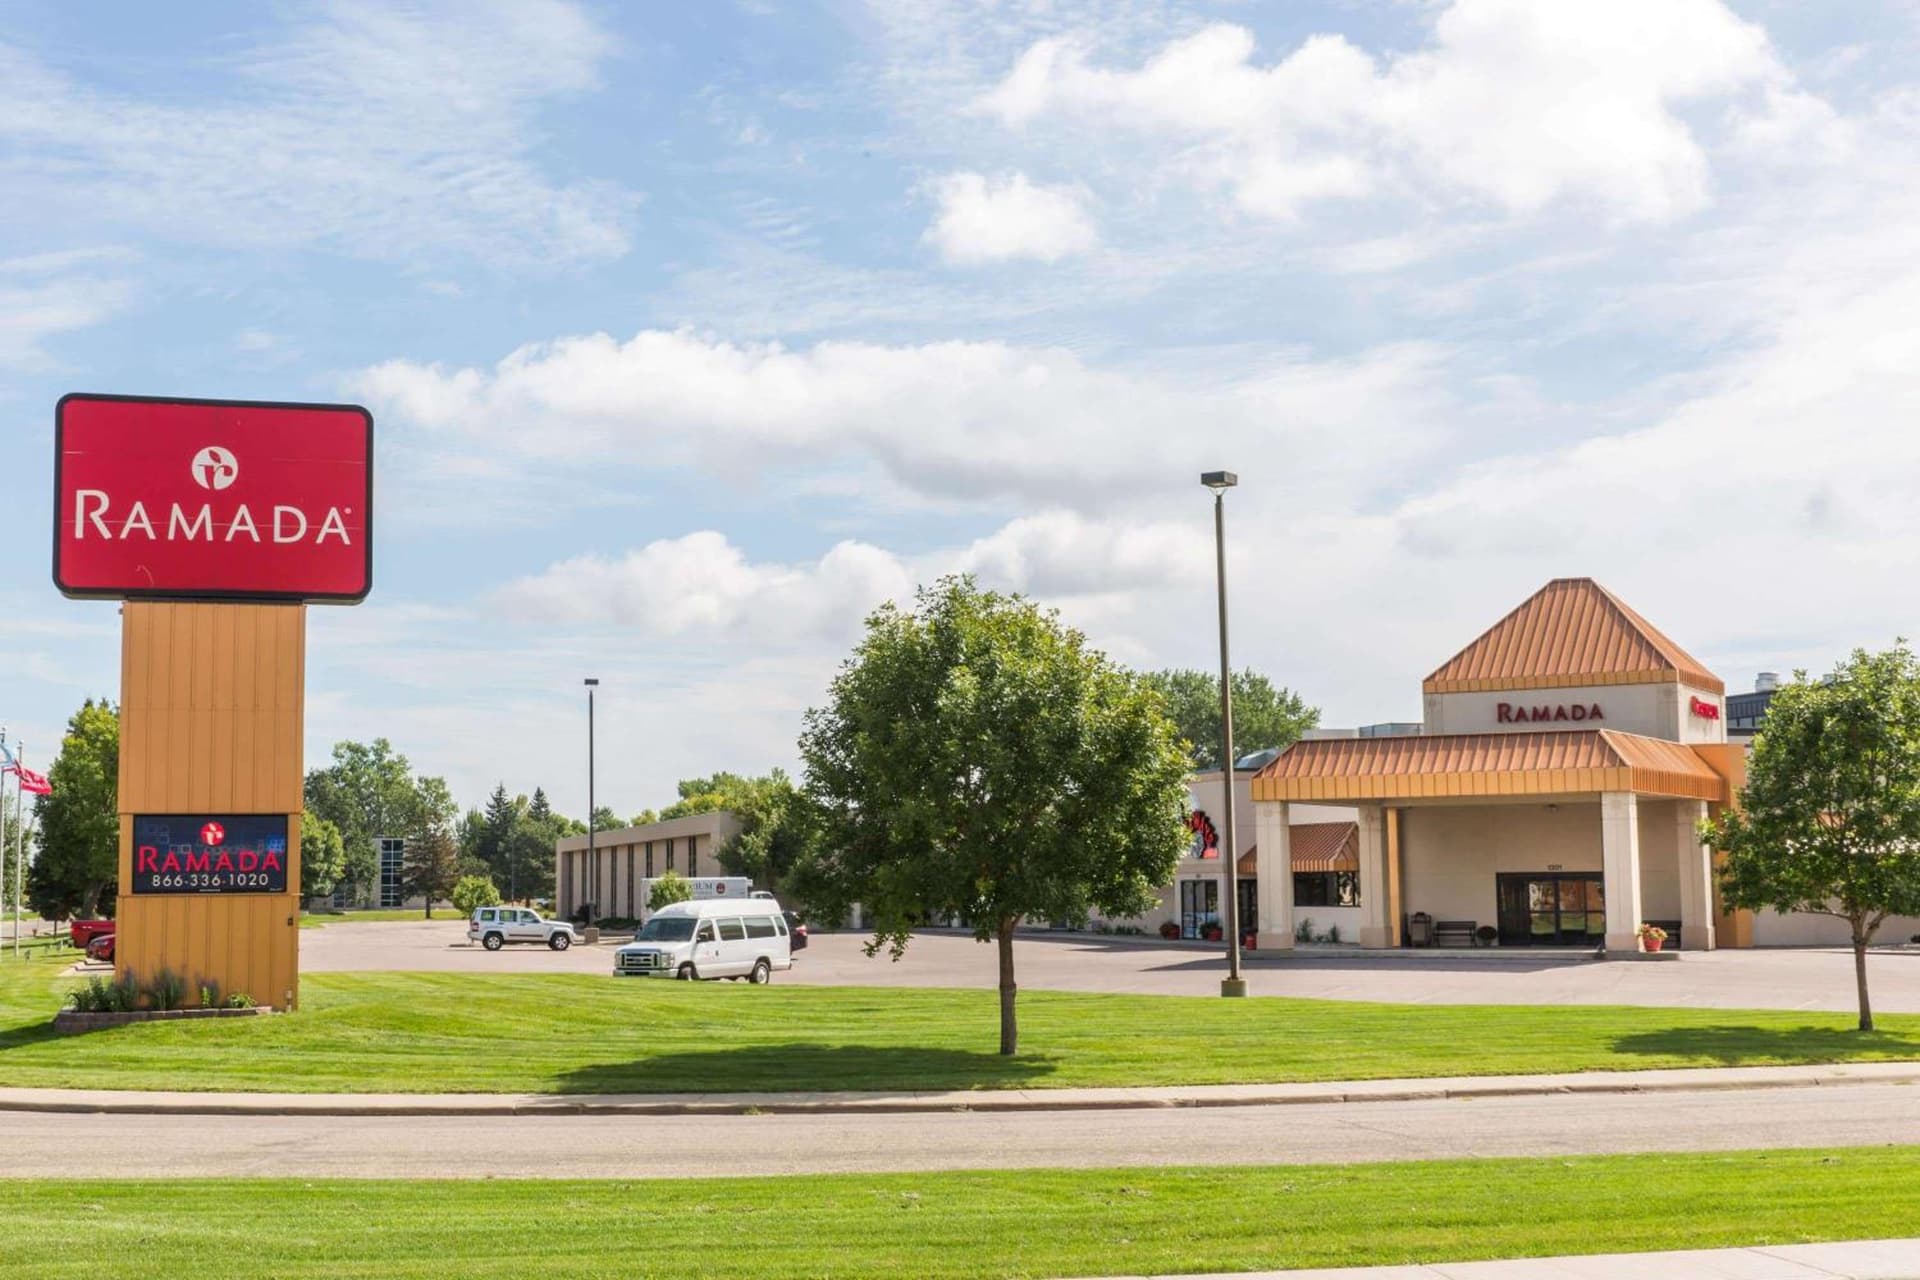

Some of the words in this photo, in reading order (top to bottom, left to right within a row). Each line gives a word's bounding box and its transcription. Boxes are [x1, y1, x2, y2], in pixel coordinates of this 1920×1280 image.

[75, 489, 351, 545] RAMADA
[1497, 702, 1604, 723] RAMADA
[138, 845, 281, 873] RAMADA
[152, 873, 269, 887] 866-336-1020
